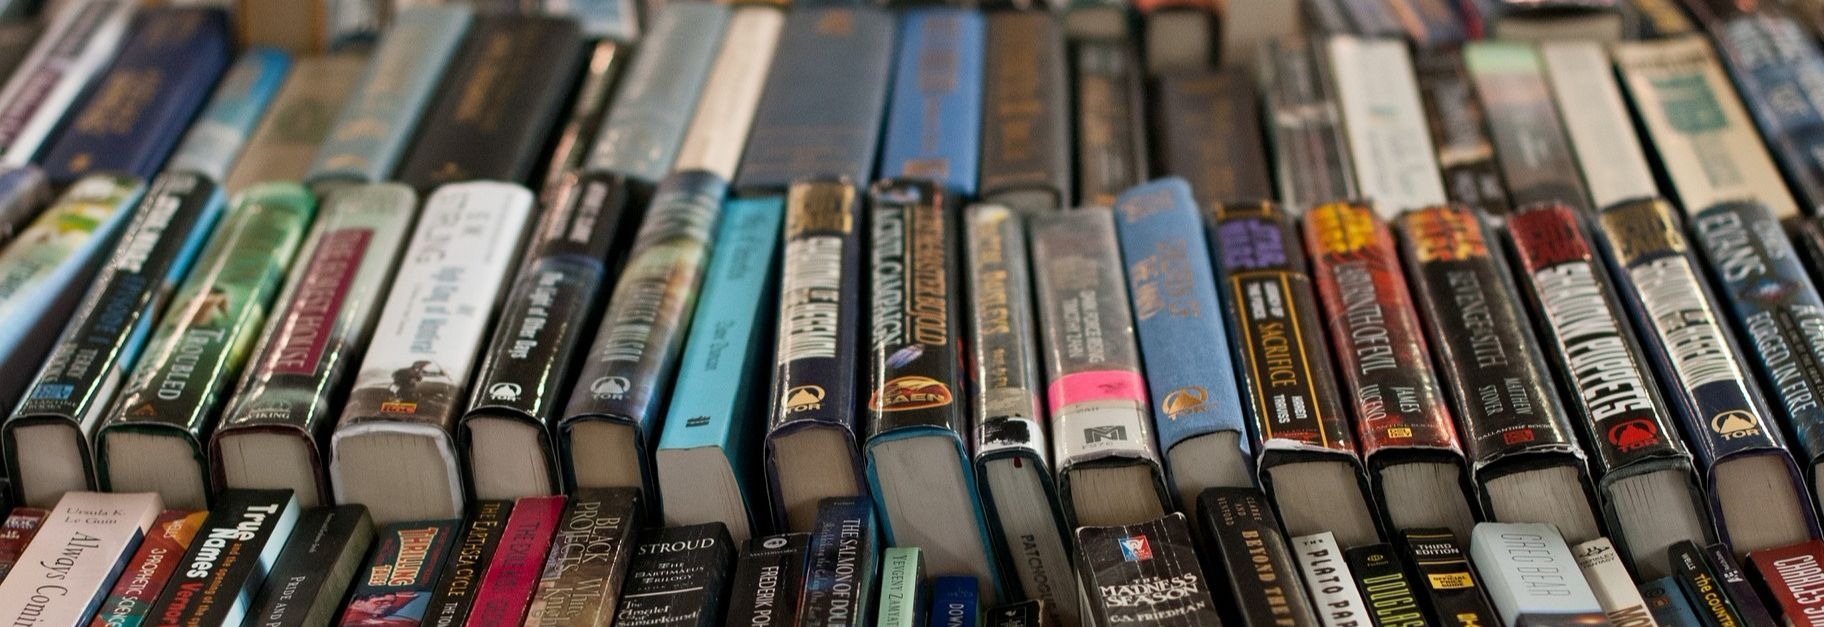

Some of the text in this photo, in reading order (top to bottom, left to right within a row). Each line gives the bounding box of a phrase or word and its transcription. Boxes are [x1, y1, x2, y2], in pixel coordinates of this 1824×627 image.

[1701, 211, 1767, 284] EVANS
[1535, 262, 1612, 340] SHADOW
[1258, 322, 1296, 388] SACRIFICE
[1746, 310, 1790, 367] FORGED
[157, 328, 226, 400] TROUBLED
[1356, 345, 1398, 374] EVIL
[1772, 362, 1801, 386] IN
[1565, 335, 1645, 422] PUPPETS
[592, 392, 625, 401] TOR
[784, 403, 821, 413] TOR
[1273, 394, 1290, 424] TRAVISS
[1291, 395, 1308, 419] KAREN
[1360, 384, 1387, 421] LUCENO
[1390, 386, 1421, 413] JAMES
[1479, 384, 1504, 417] STOVER
[1504, 377, 1534, 414] MATTHEW
[1781, 380, 1817, 418] FIRE
[1615, 438, 1660, 453] TOR
[1722, 428, 1761, 440] TOR
[66, 507, 109, 517] Ursula
[87, 517, 117, 525] Guin
[244, 503, 279, 541] True
[841, 518, 861, 538] THE
[187, 527, 241, 578] Names
[448, 503, 500, 597] THE EARTHSEA CYCLE
[559, 502, 600, 573] PROJECTS
[583, 517, 620, 564] BLACK
[638, 538, 715, 555] STROUD
[1415, 548, 1460, 556] EDITION
[40, 531, 102, 581] Always
[635, 566, 705, 578] BARTIMAEUS
[835, 539, 858, 582] SALMON
[891, 555, 907, 590] YEVGENY
[1242, 530, 1290, 614] BEYOND THE
[1307, 549, 1344, 594] PLATO
[1501, 533, 1572, 596] GREG BEAR
[125, 555, 163, 595] PROPHETIC
[204, 569, 228, 595] opening
[280, 576, 306, 602] PRIDE
[643, 575, 693, 584] TRILOGY
[755, 566, 779, 608] FREDERIK
[832, 583, 852, 598] OF
[1100, 572, 1198, 597] MADNESS
[1694, 573, 1711, 593] The
[1773, 554, 1824, 604] CHARLES
[163, 582, 204, 624] Vernor
[271, 603, 287, 620] AND
[442, 602, 458, 615] THE
[566, 578, 603, 618] White
[1106, 583, 1199, 608] SEASON
[1137, 600, 1205, 622] FRIEDMAN
